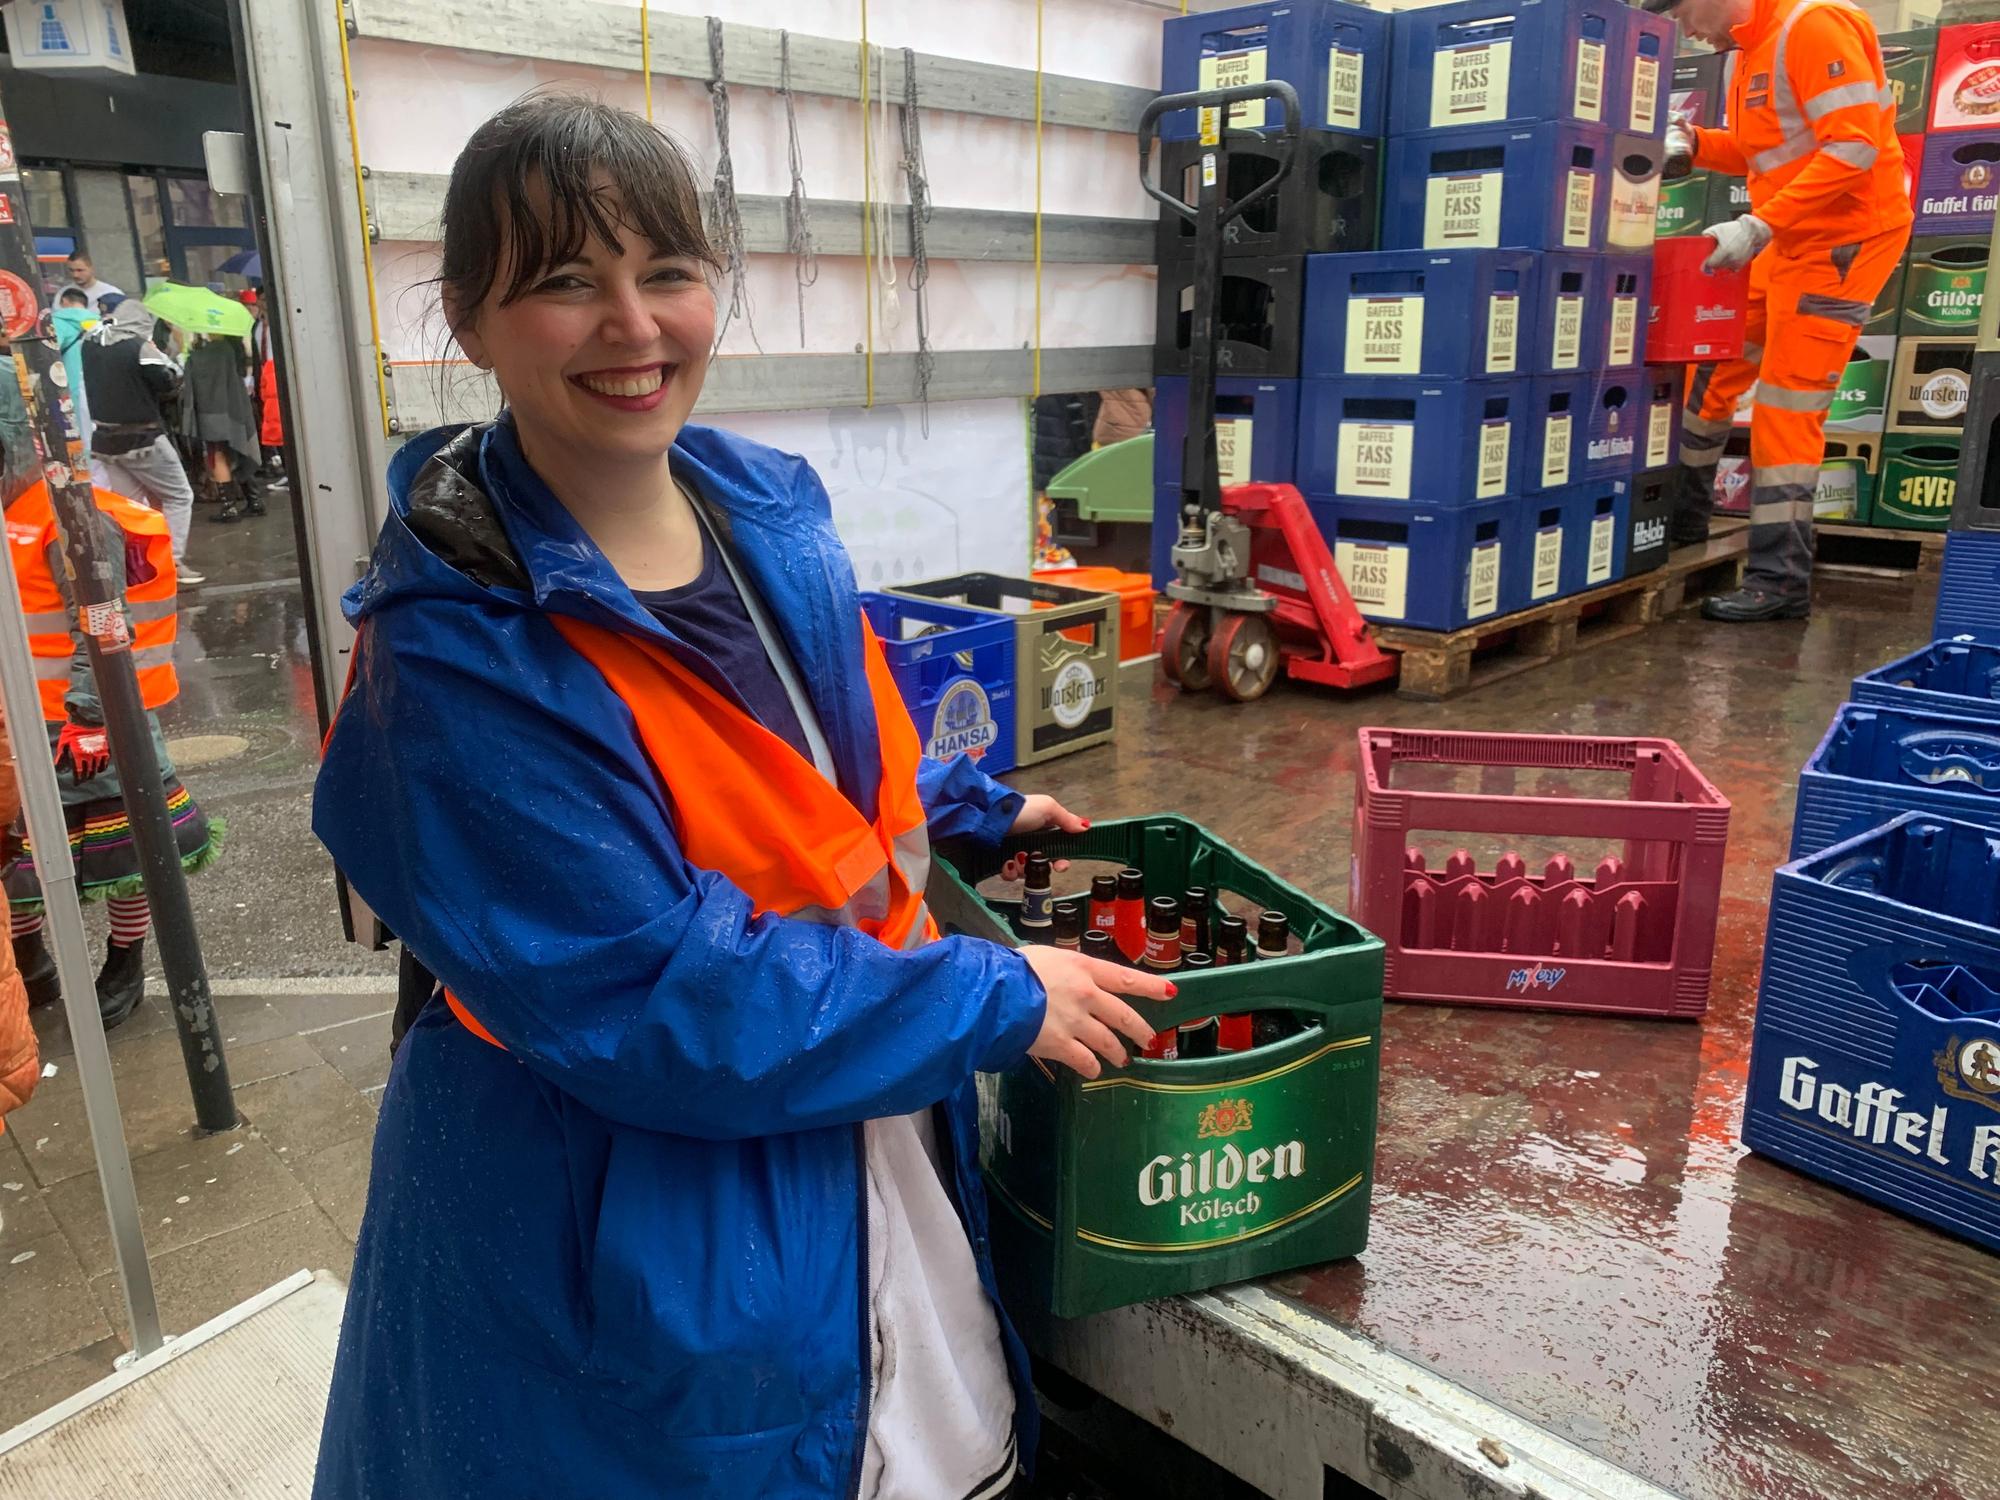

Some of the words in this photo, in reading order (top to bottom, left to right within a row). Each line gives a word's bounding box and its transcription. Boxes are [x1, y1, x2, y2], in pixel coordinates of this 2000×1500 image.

[1216, 59, 1249, 74] GAFFELS
[1453, 52, 1490, 68] GAFFELS
[1334, 71, 1358, 93] FASS
[1451, 68, 1489, 91] FASS
[1581, 61, 1600, 86] FASS
[1637, 78, 1654, 98] FASS
[1450, 91, 1487, 107] BRAUSE
[1446, 181, 1482, 195] GAFFELS
[1444, 195, 1481, 217] FASS
[1571, 192, 1589, 212] FASS
[1922, 196, 1968, 215] Gaffel
[1972, 195, 1998, 212] Köl
[1443, 217, 1480, 231] BRAUSE
[1366, 305, 1403, 318] GAFFELS
[1365, 320, 1403, 340] FASS
[1493, 318, 1513, 338] FASS
[1559, 317, 1577, 336] FASS
[1615, 316, 1632, 334] FASS
[1364, 343, 1402, 355] BRAUSE
[1909, 386, 1968, 403] Warstein
[1358, 431, 1394, 443] GAFFELS
[1549, 435, 1567, 454] FASS
[1220, 439, 1235, 456] SS
[1356, 445, 1393, 464] FASS
[1484, 444, 1505, 463] FASS
[1356, 466, 1391, 479] BRAUSE
[1353, 551, 1388, 564] GAFFELS
[1538, 548, 1557, 566] FASS
[1352, 564, 1387, 585] FASS
[1475, 564, 1495, 585] FASS
[1351, 585, 1385, 599] BRAUSE
[935, 726, 991, 757] HANSA
[1779, 1056, 1950, 1166] Gaffel
[1138, 1140, 1306, 1206] Gilden
[1180, 1191, 1262, 1226] Kölsch
